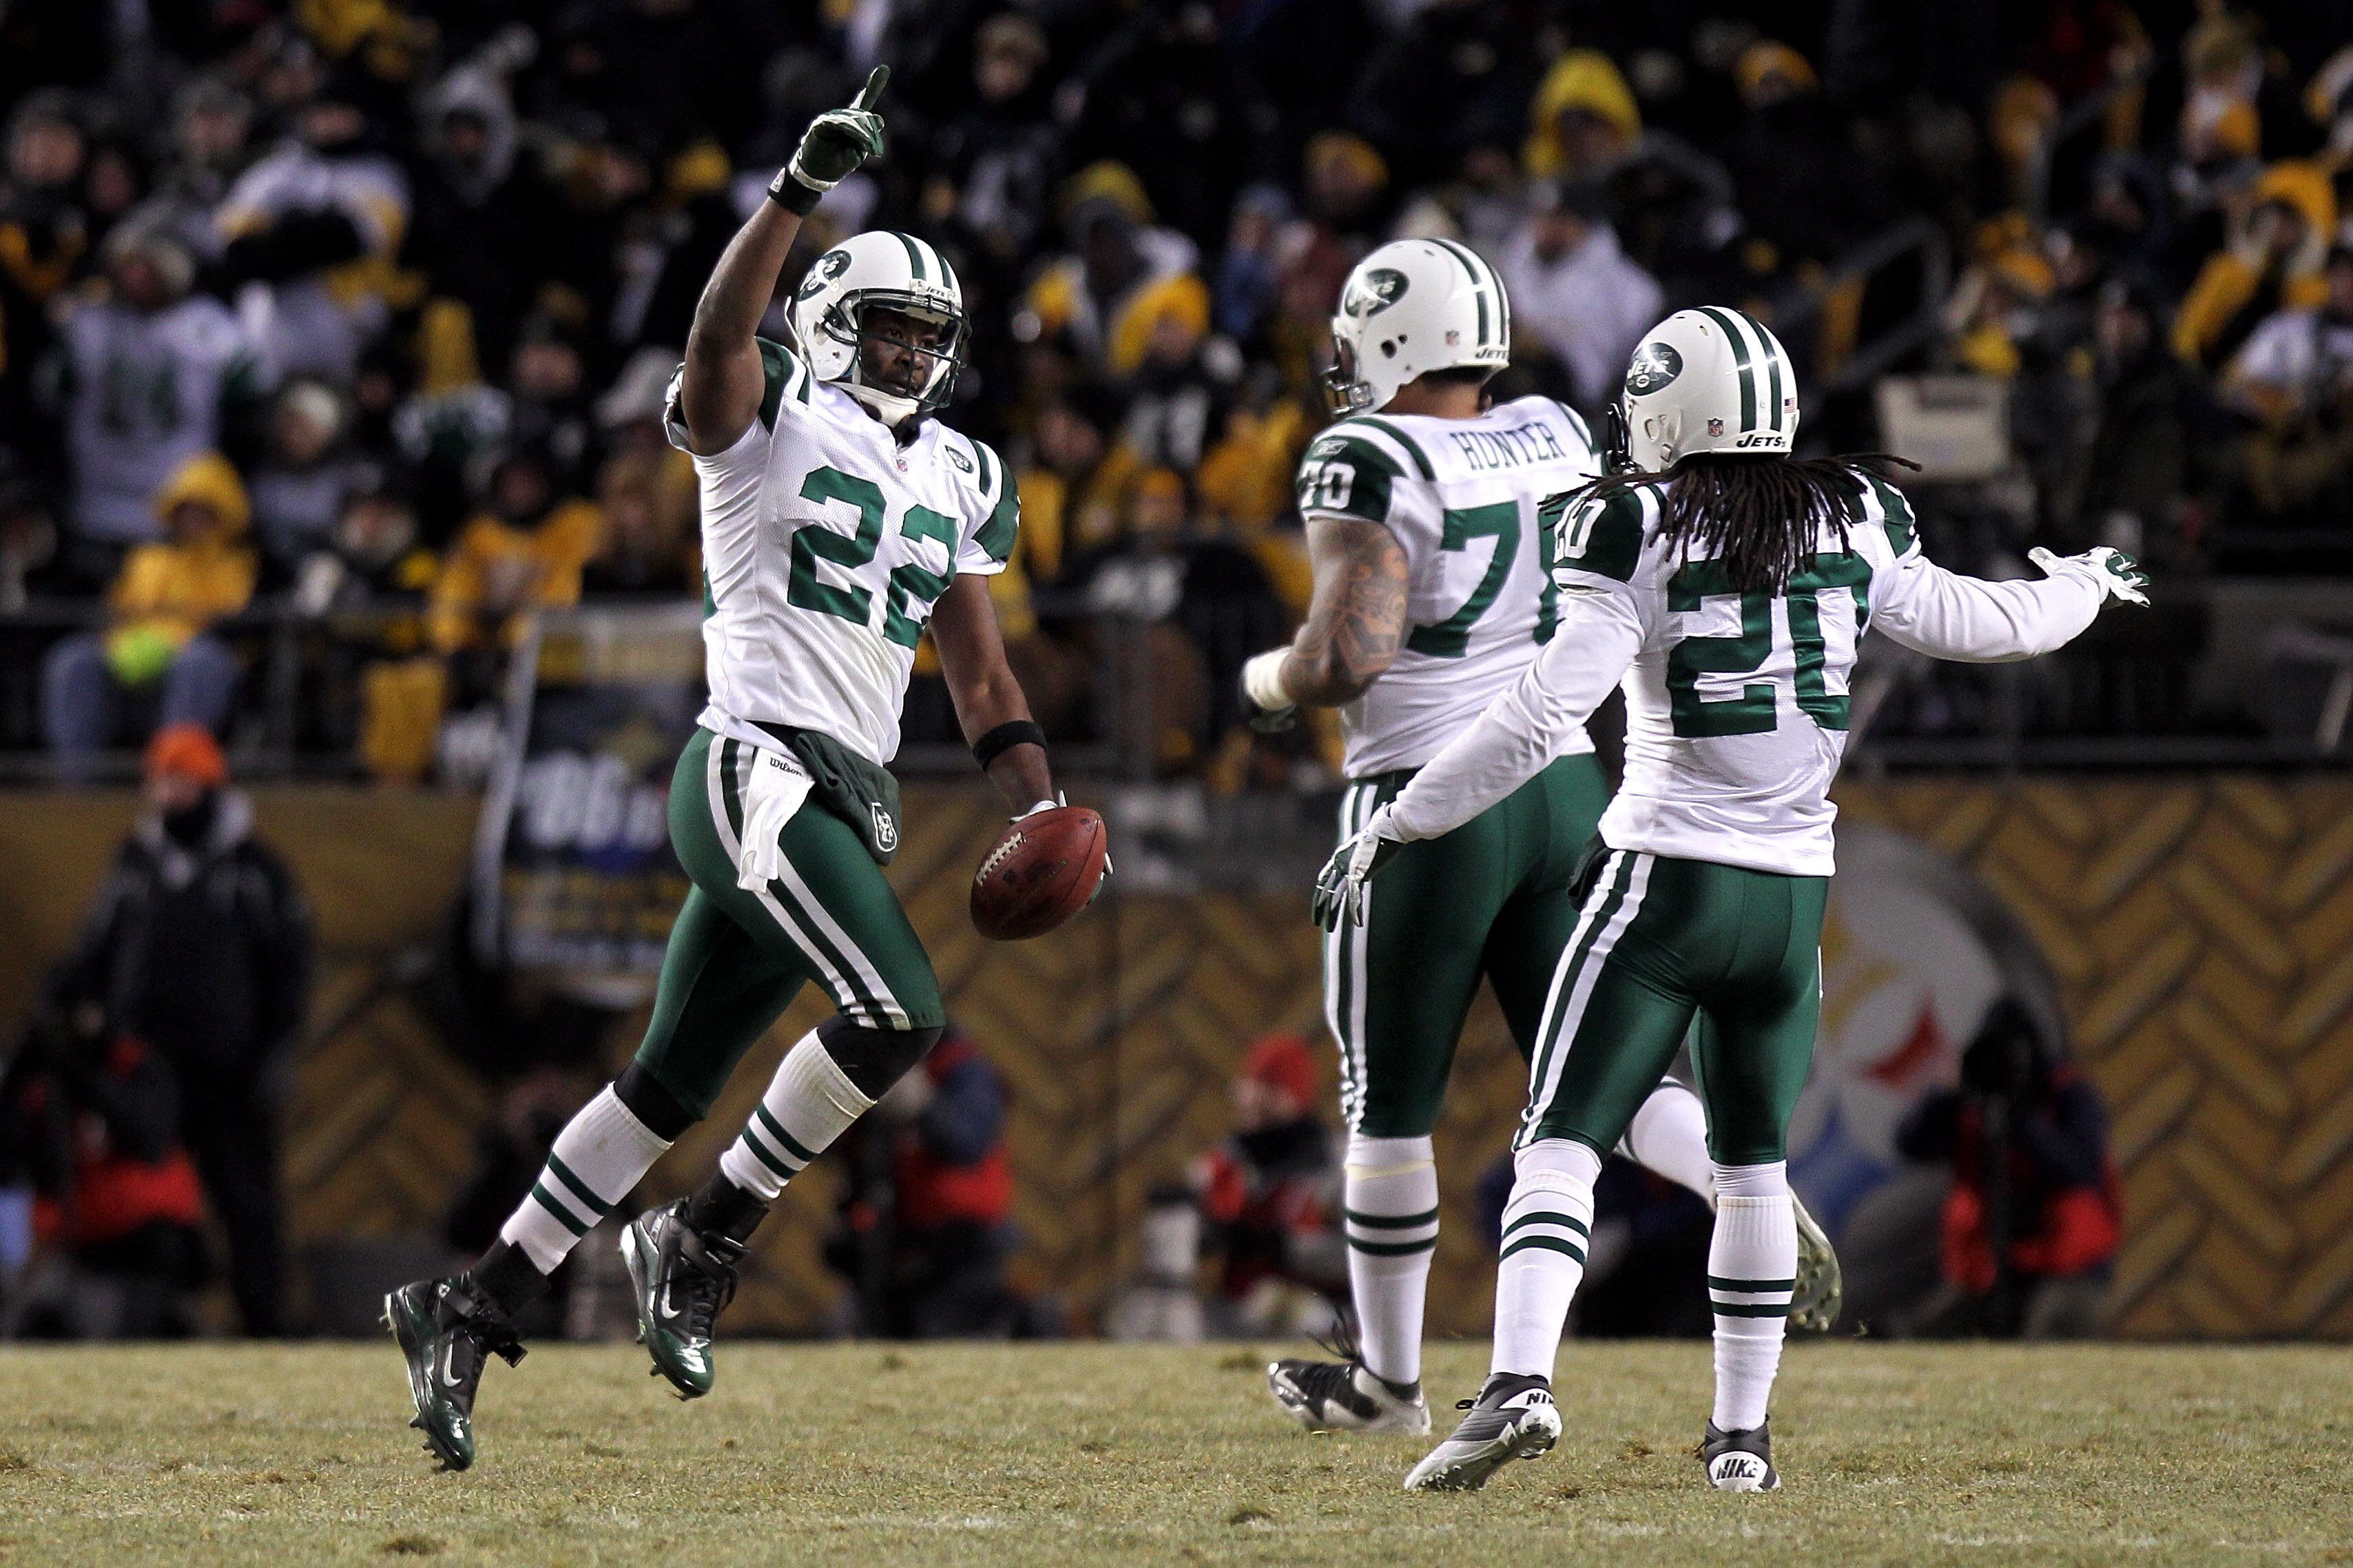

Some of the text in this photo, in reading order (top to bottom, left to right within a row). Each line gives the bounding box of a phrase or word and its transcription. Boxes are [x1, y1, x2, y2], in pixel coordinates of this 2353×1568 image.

[1449, 421, 1566, 470] HUNTER
[1737, 434, 1783, 448] JETS
[1298, 461, 1356, 509] 70
[787, 465, 958, 650] 22
[1406, 493, 1559, 658] 7
[1666, 549, 1873, 738] 20
[769, 757, 804, 777] Wilson
[1716, 1459, 1758, 1480] NIKE
